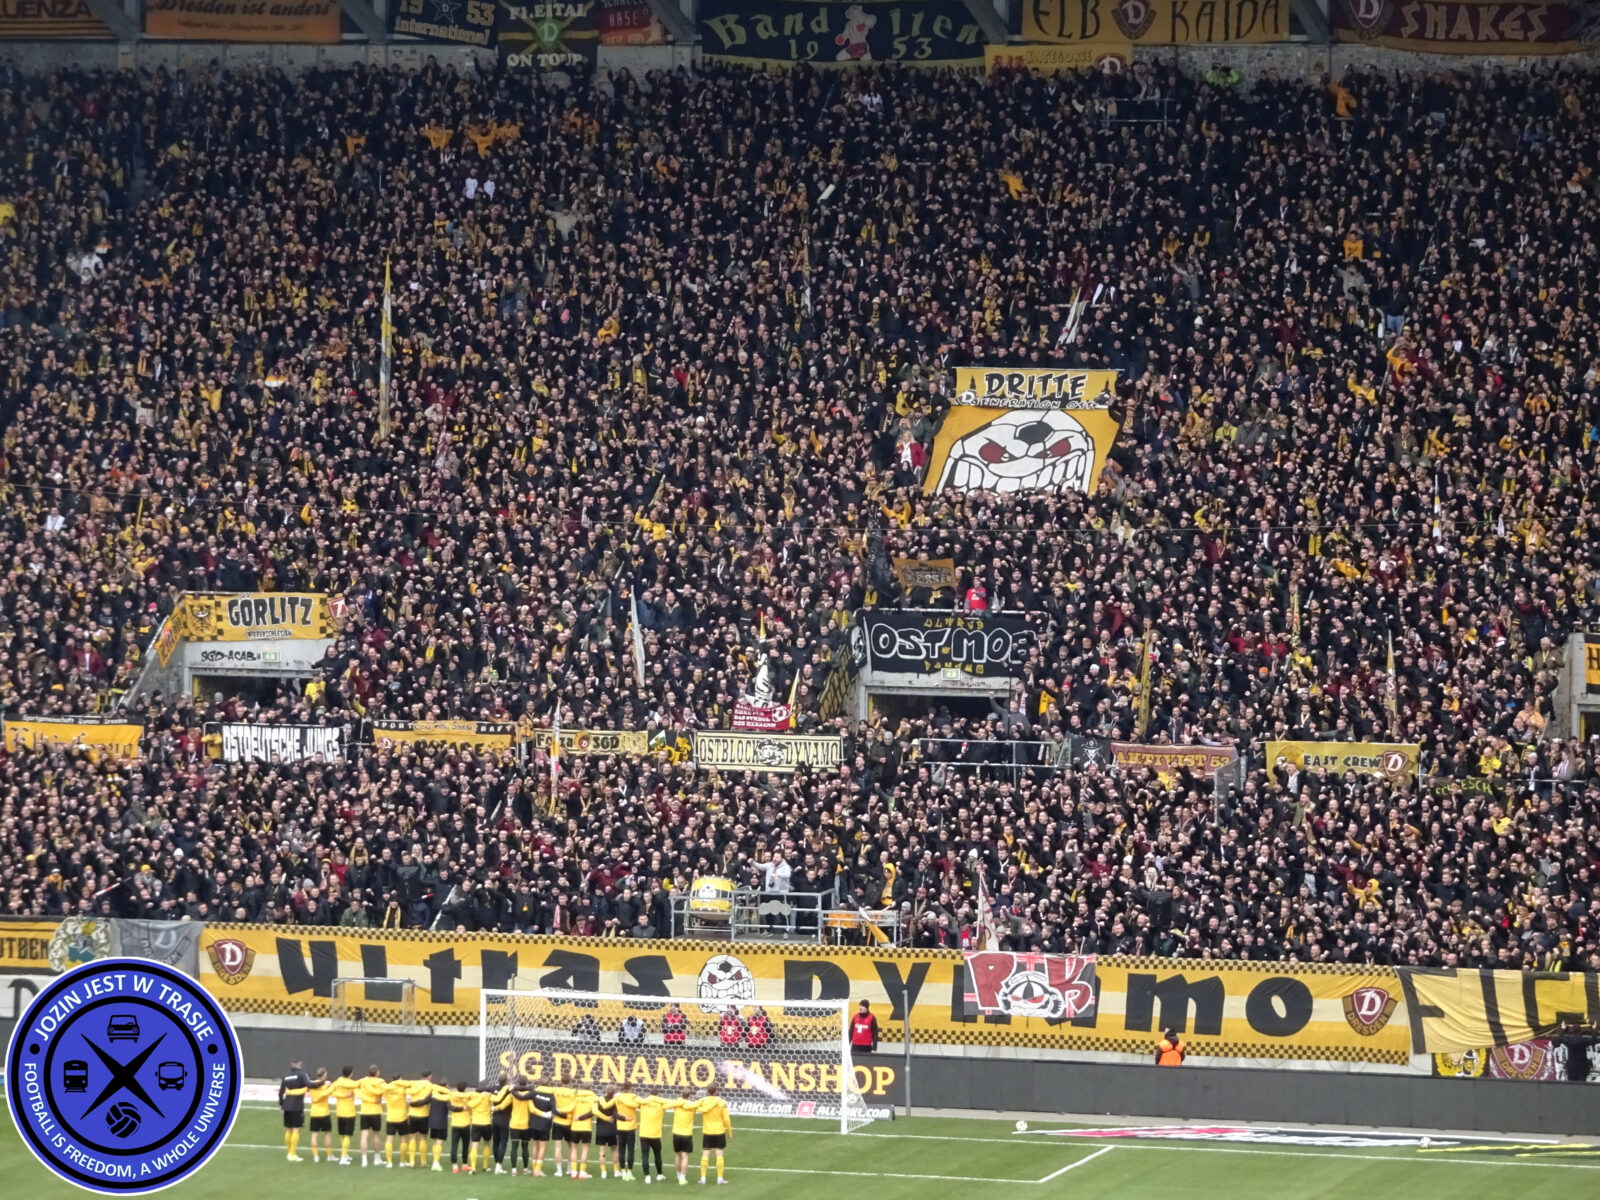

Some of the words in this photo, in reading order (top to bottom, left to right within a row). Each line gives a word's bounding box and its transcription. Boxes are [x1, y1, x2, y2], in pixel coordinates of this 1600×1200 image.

[466, 1, 496, 26] 53
[609, 10, 639, 28] HASE
[1032, 0, 1101, 39] ELB
[1170, 0, 1281, 42] KAIDA
[1401, 1, 1548, 43] SNAKES
[507, 53, 532, 67] ON
[789, 39, 819, 60] 19
[893, 36, 932, 60] 53
[984, 373, 1087, 399] DRITTE
[227, 593, 314, 627] GÖRLITZ
[871, 623, 952, 659] OST
[592, 735, 620, 749] SGD
[785, 742, 840, 767] DYNAMO
[1303, 754, 1338, 767] EAST
[1343, 756, 1382, 769] CREW
[499, 1050, 543, 1082] SG
[552, 1053, 716, 1088] DYNAMO
[723, 1060, 896, 1096] FANSHOP
